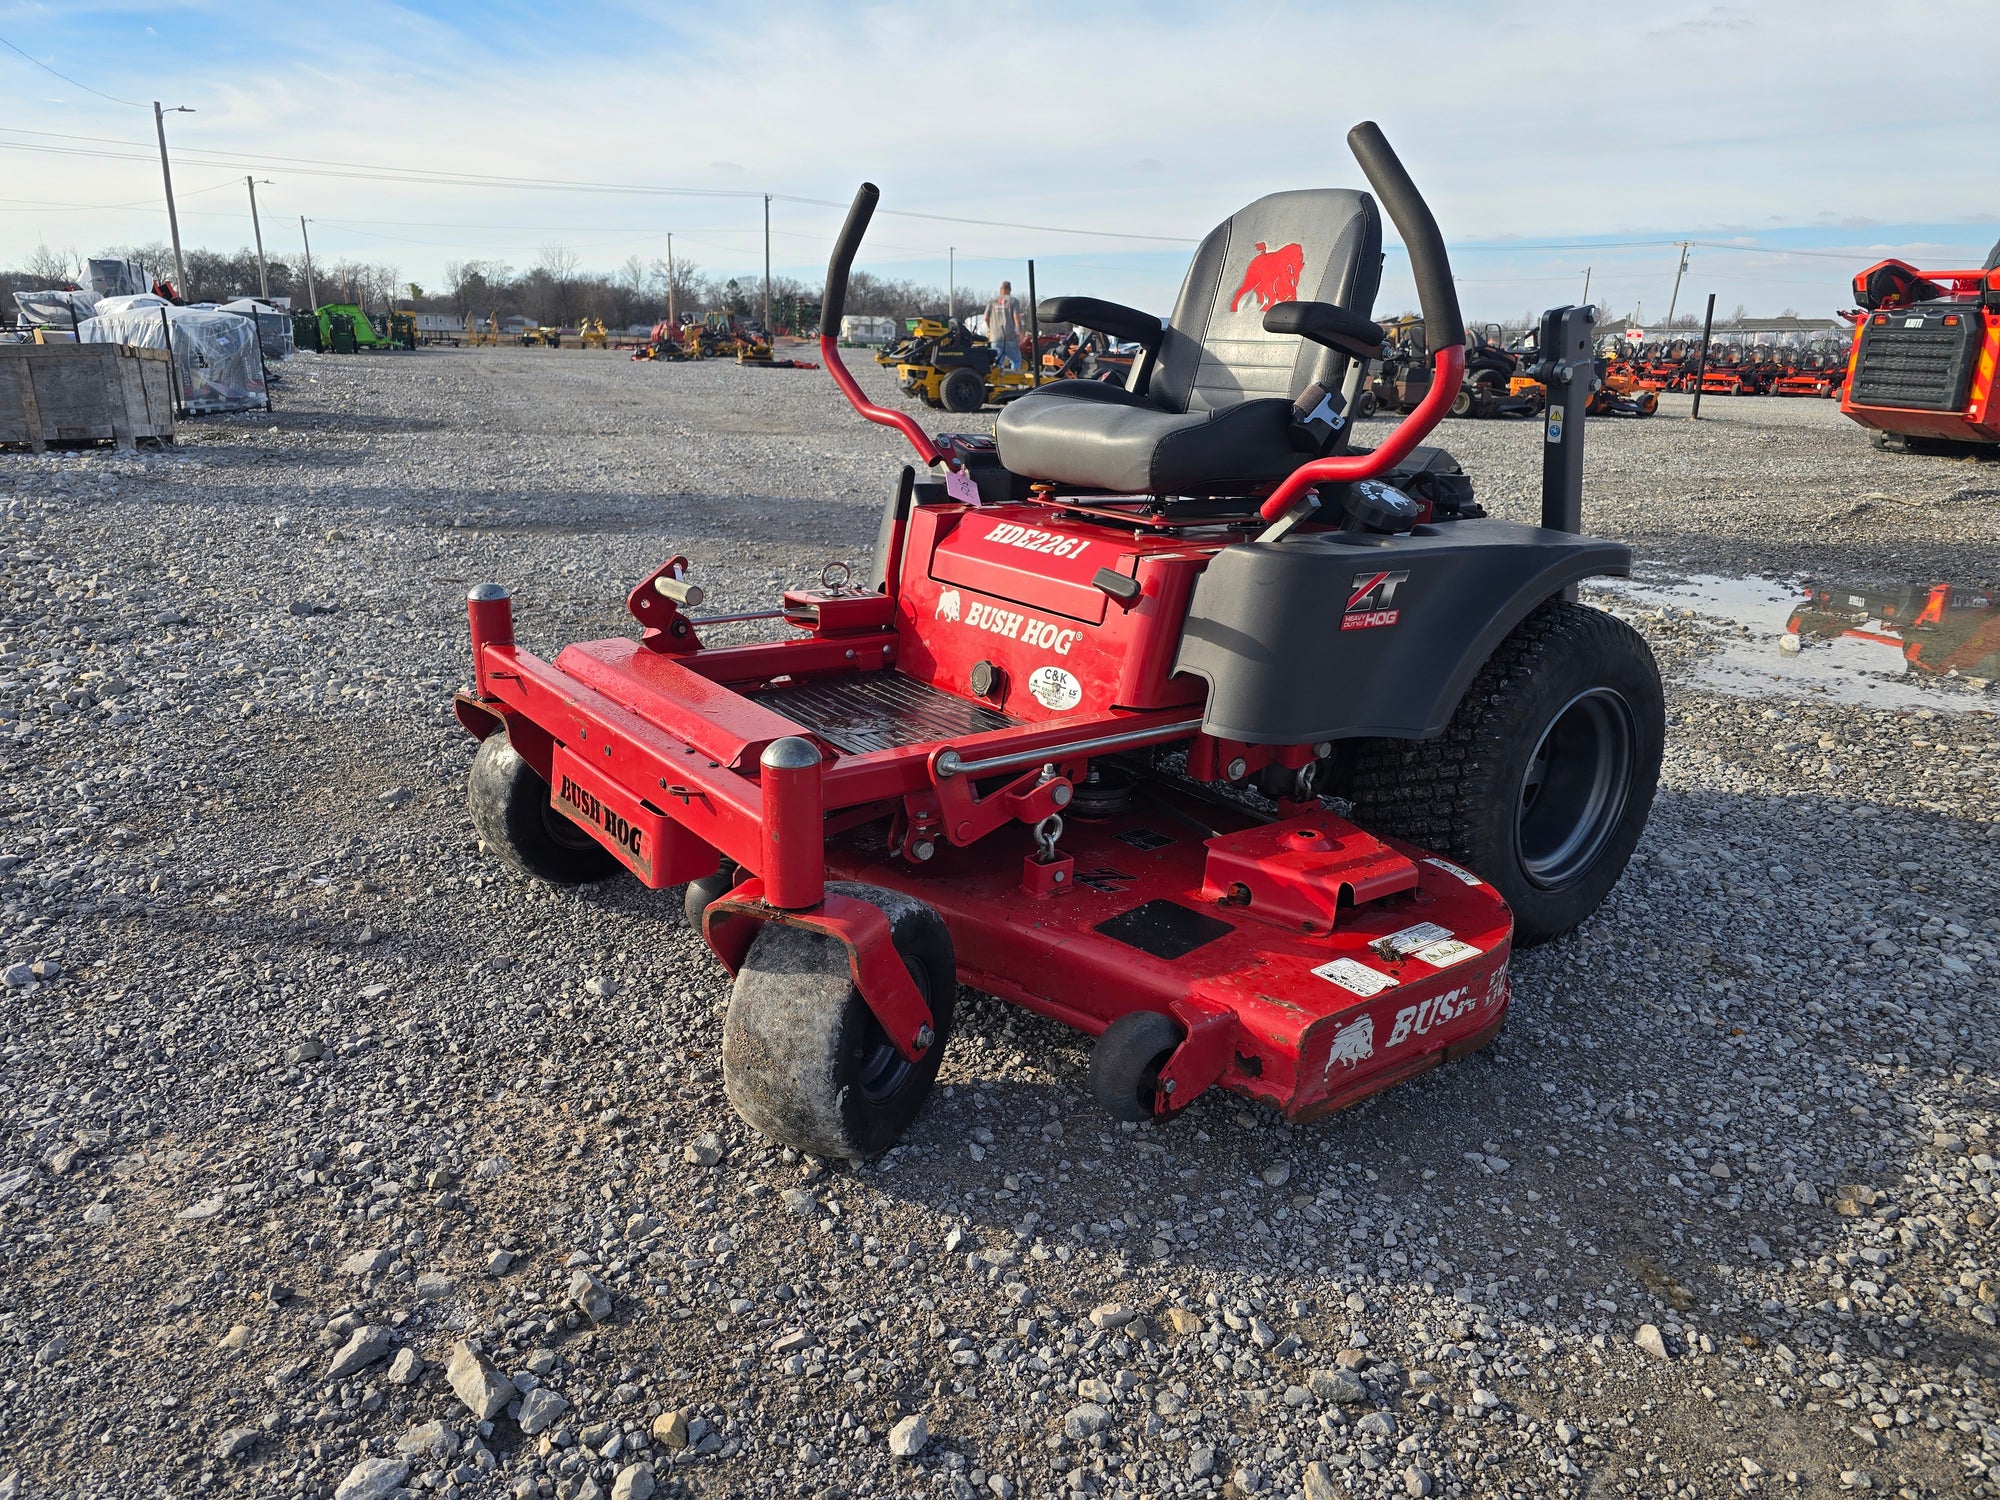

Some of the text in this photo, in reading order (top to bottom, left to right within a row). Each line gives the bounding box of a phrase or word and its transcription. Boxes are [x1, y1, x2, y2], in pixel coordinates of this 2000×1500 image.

[983, 522, 1092, 560] HDE2261
[1345, 569, 1410, 613] ZT
[964, 601, 1024, 639] BUSH
[1364, 610, 1397, 627] HOG
[1044, 668, 1068, 685] C&K
[560, 773, 642, 857] BUSH HOG
